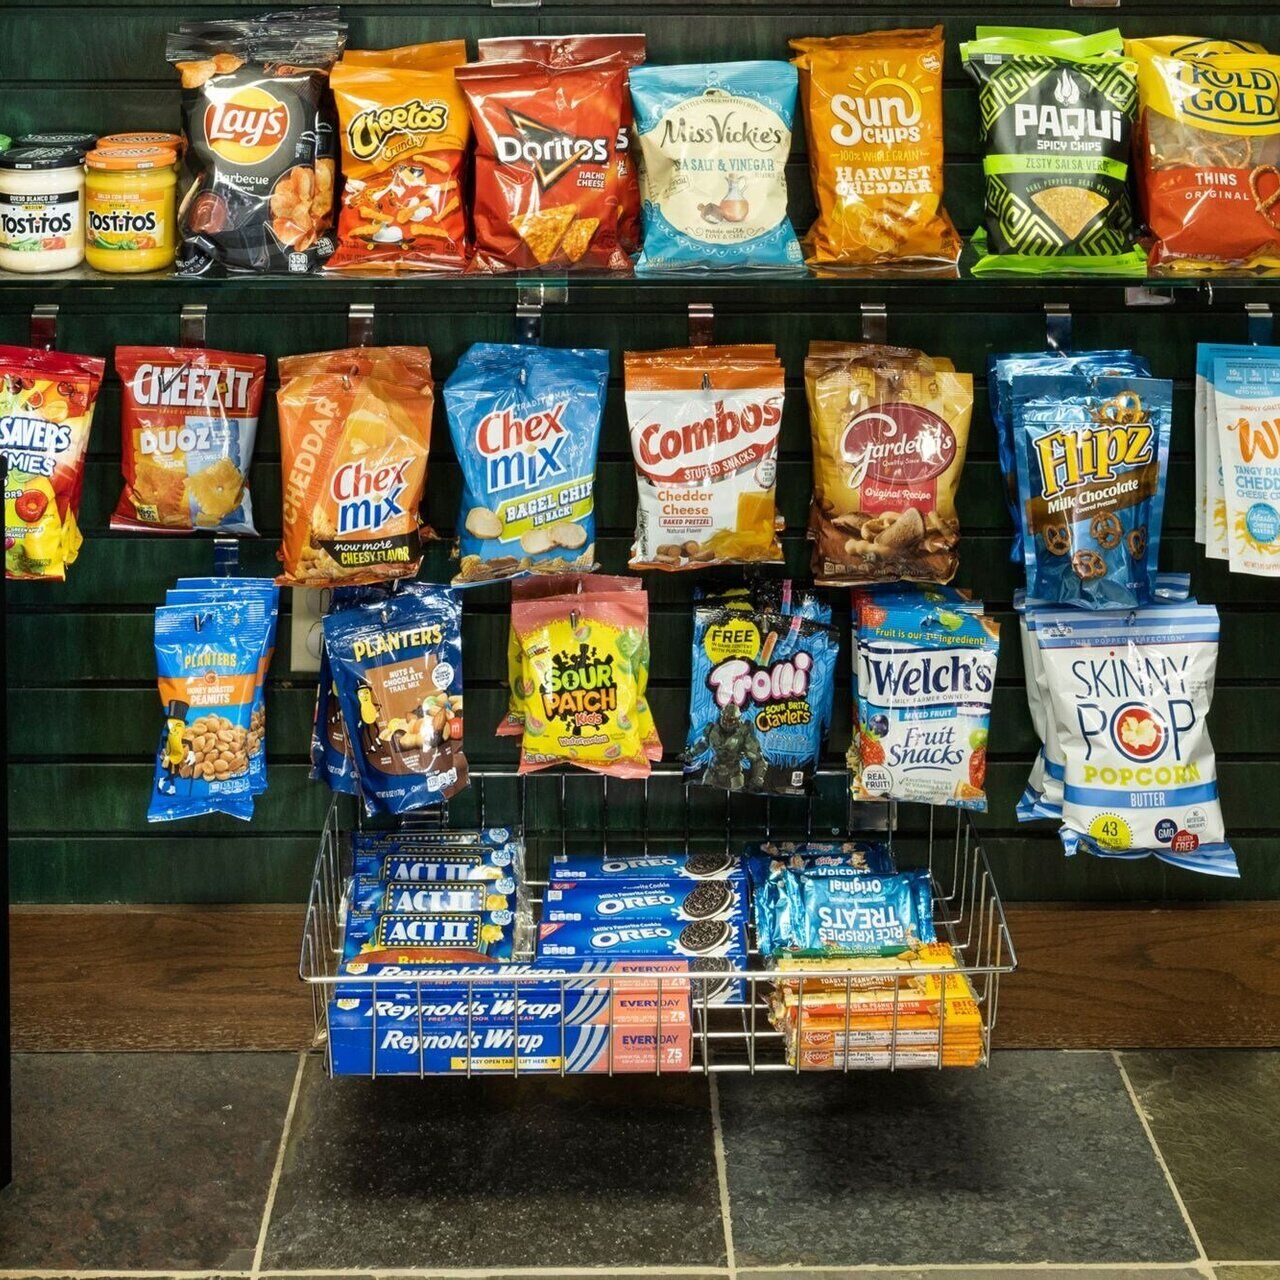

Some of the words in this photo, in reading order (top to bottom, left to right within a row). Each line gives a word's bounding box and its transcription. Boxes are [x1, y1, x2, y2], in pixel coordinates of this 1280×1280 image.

[209, 104, 286, 147] Lay's
[349, 100, 448, 146] Cheetos
[660, 111, 712, 147] Miss
[715, 110, 781, 147] Vickie's
[831, 89, 924, 147] Sun
[863, 125, 921, 143] CHIPS
[1037, 139, 1069, 151] SPICY
[498, 137, 609, 163] Doritos
[729, 157, 775, 171] VINEGAR
[835, 165, 931, 181] HARVEST
[578, 172, 605, 180] NACHO
[835, 180, 934, 195] CHEDDAR
[1195, 172, 1237, 187] THINS
[477, 401, 563, 457] Chex
[640, 401, 781, 462] Combos
[140, 429, 210, 454] DUOZ
[684, 462, 720, 481] STUFFED
[722, 449, 756, 466] SNACKS
[1036, 424, 1153, 499] Flipz
[1234, 465, 1264, 476] TANGY
[505, 491, 553, 520] BAGEL
[657, 490, 713, 503] Cheddar
[1047, 497, 1076, 513] Milk
[1079, 479, 1138, 506] Chocolate
[662, 504, 708, 516] Cheese
[334, 542, 357, 552] now
[361, 540, 391, 550] more
[376, 546, 409, 561] FLAVOR
[353, 625, 442, 662] PLANTERS
[875, 626, 897, 638] Fruit
[546, 664, 613, 691] SOUR
[707, 653, 813, 705] Trolli
[872, 655, 993, 696] Welch's
[1071, 652, 1189, 698] SKINNY
[191, 691, 230, 705] PEANUTS
[544, 689, 616, 717] PATCH
[755, 708, 811, 732] Crawlers
[1077, 698, 1195, 763] POP
[888, 746, 963, 765] Snacks
[1083, 763, 1200, 786] POPCORN
[1130, 791, 1165, 807] BUTTER
[1102, 822, 1118, 837] 43
[818, 906, 900, 928] TREATS
[391, 916, 436, 944] ACT
[590, 928, 655, 947] OREO
[819, 926, 875, 943] KRISPIES
[876, 925, 905, 938] RICE
[380, 1029, 484, 1052] Reynolds
[488, 1030, 545, 1054] Wrap
[622, 1035, 679, 1046] EVERYDAY
